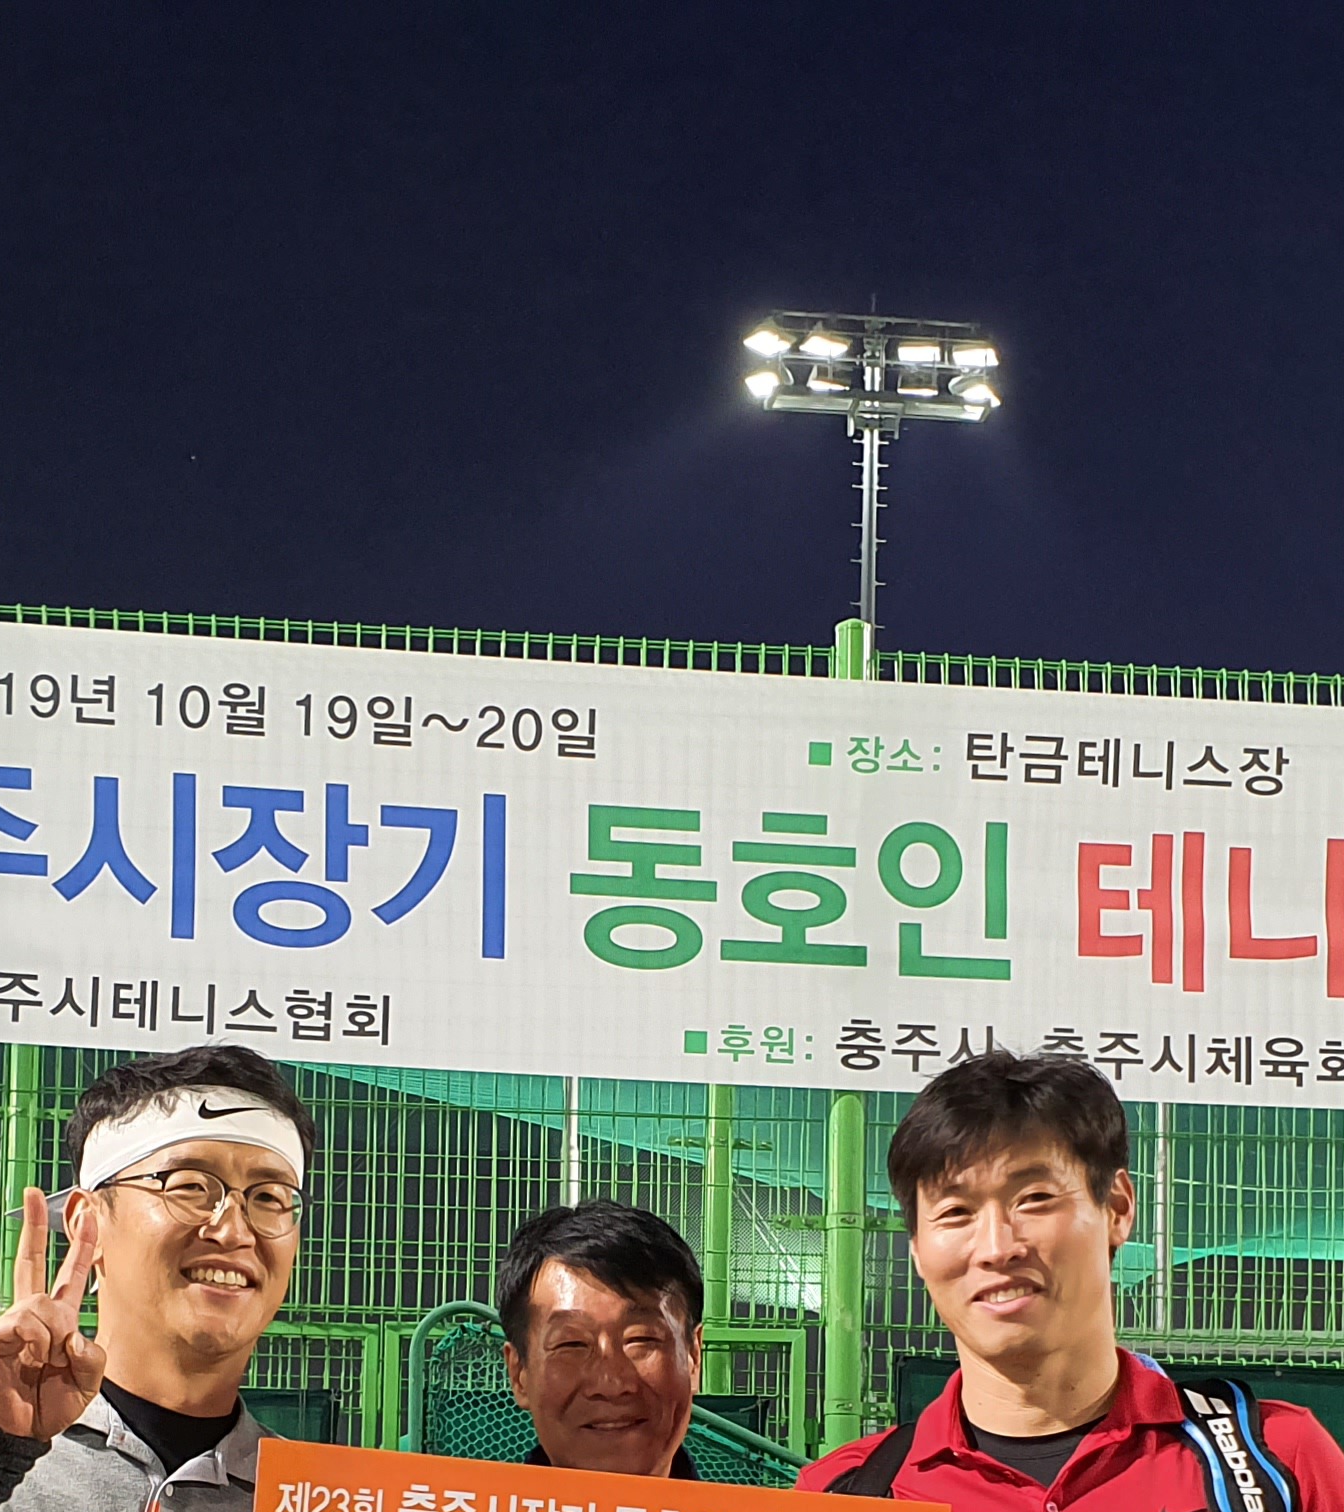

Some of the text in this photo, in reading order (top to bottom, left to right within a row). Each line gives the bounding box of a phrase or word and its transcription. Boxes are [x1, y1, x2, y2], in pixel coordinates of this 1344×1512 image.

[144, 682, 268, 737] 10월
[293, 694, 598, 759] 19일~20일
[846, 732, 1290, 796] 장소: 탄금테니스장
[569, 803, 1012, 981] 동호인
[717, 1024, 816, 1066] 후원:
